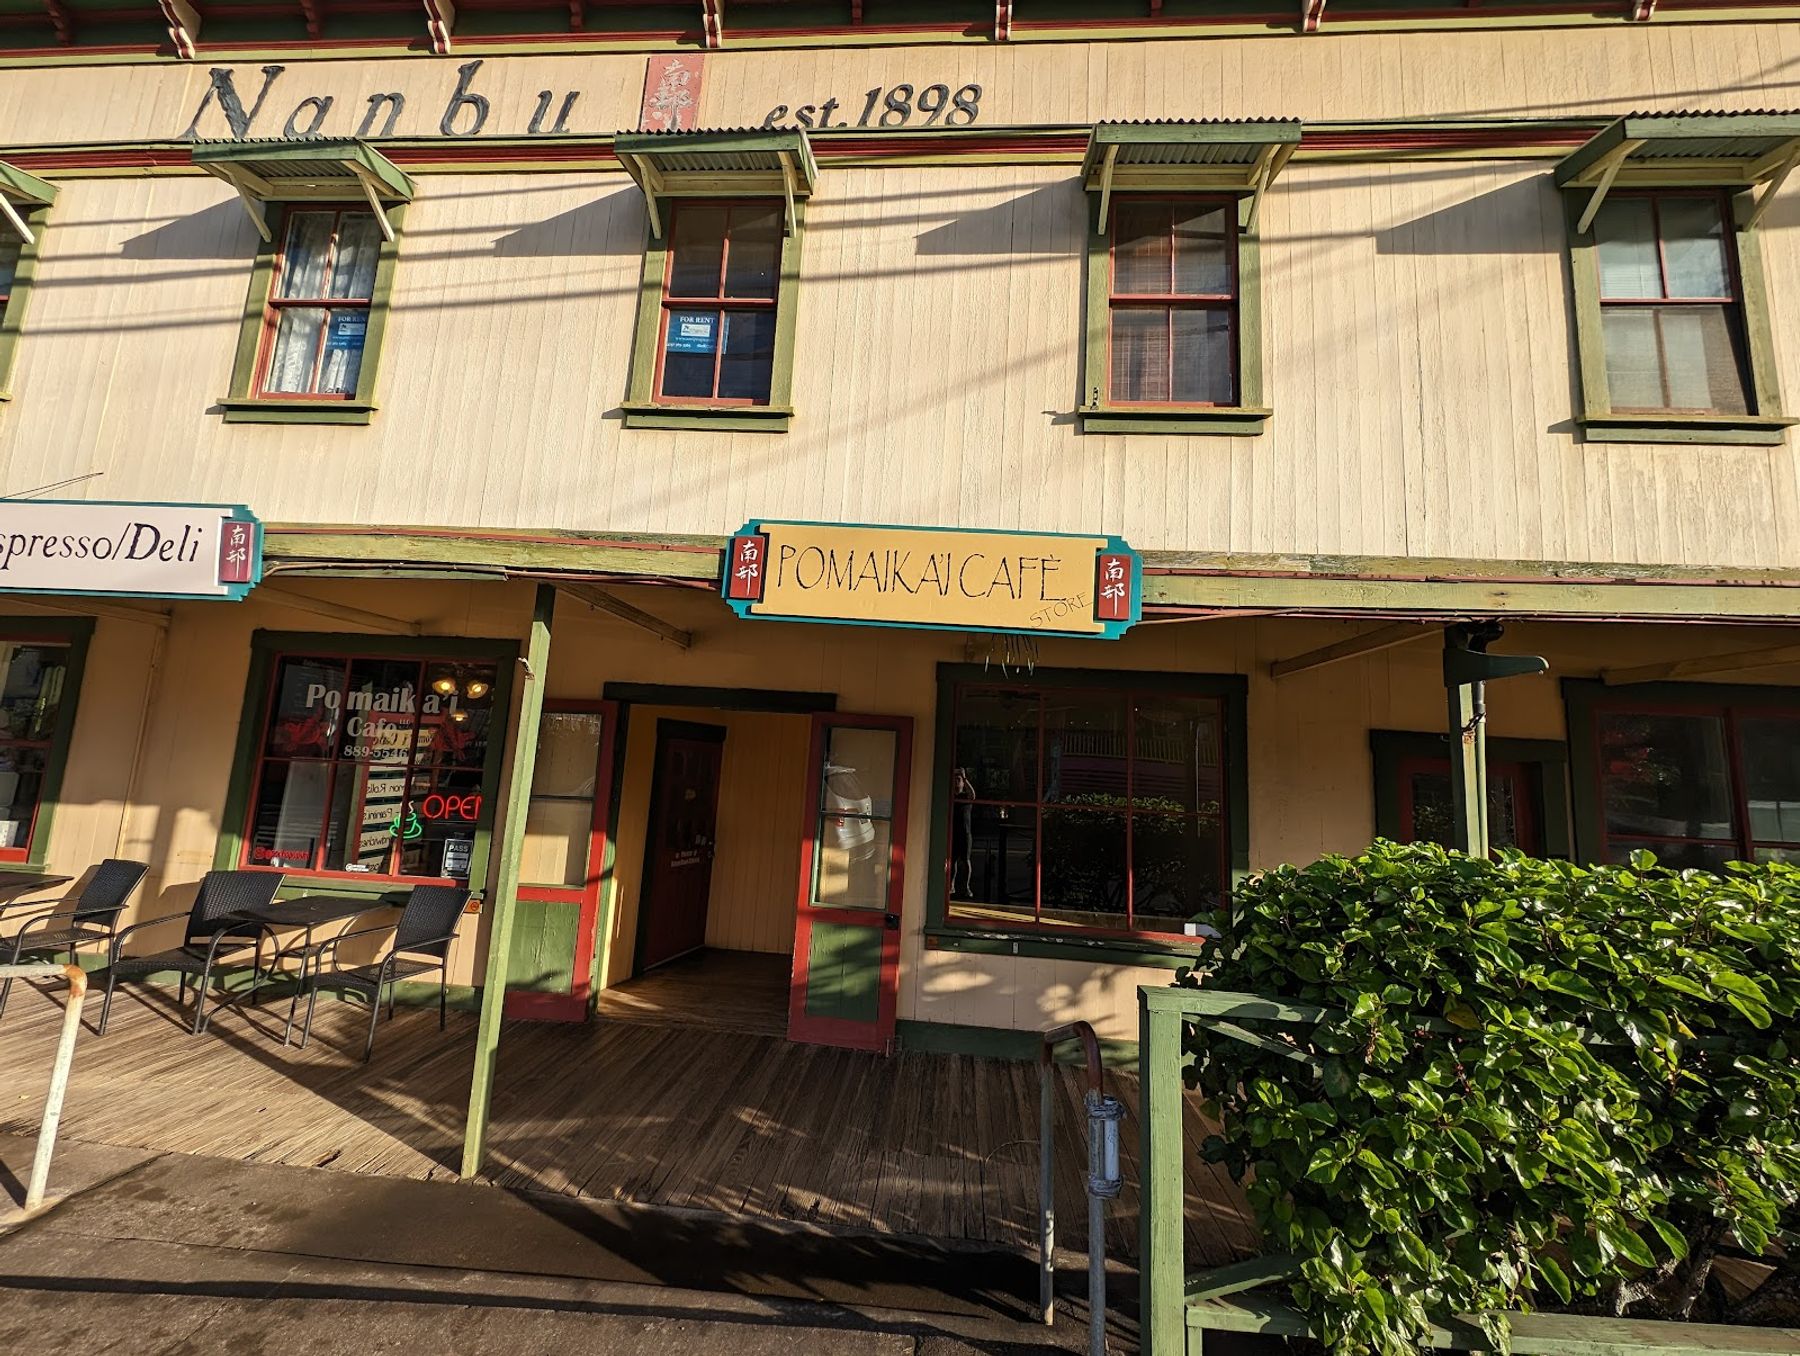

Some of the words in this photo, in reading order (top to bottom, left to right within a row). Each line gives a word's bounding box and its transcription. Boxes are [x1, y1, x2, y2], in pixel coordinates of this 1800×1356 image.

[178, 59, 581, 138] Nanbu
[226, 525, 246, 579] 南部
[735, 540, 759, 594] 南部
[1030, 592, 1094, 628] STORE
[1101, 559, 1126, 616] 南部
[347, 717, 396, 737] Cafe
[343, 745, 408, 758] 889-5546
[448, 844, 469, 852] PASS
